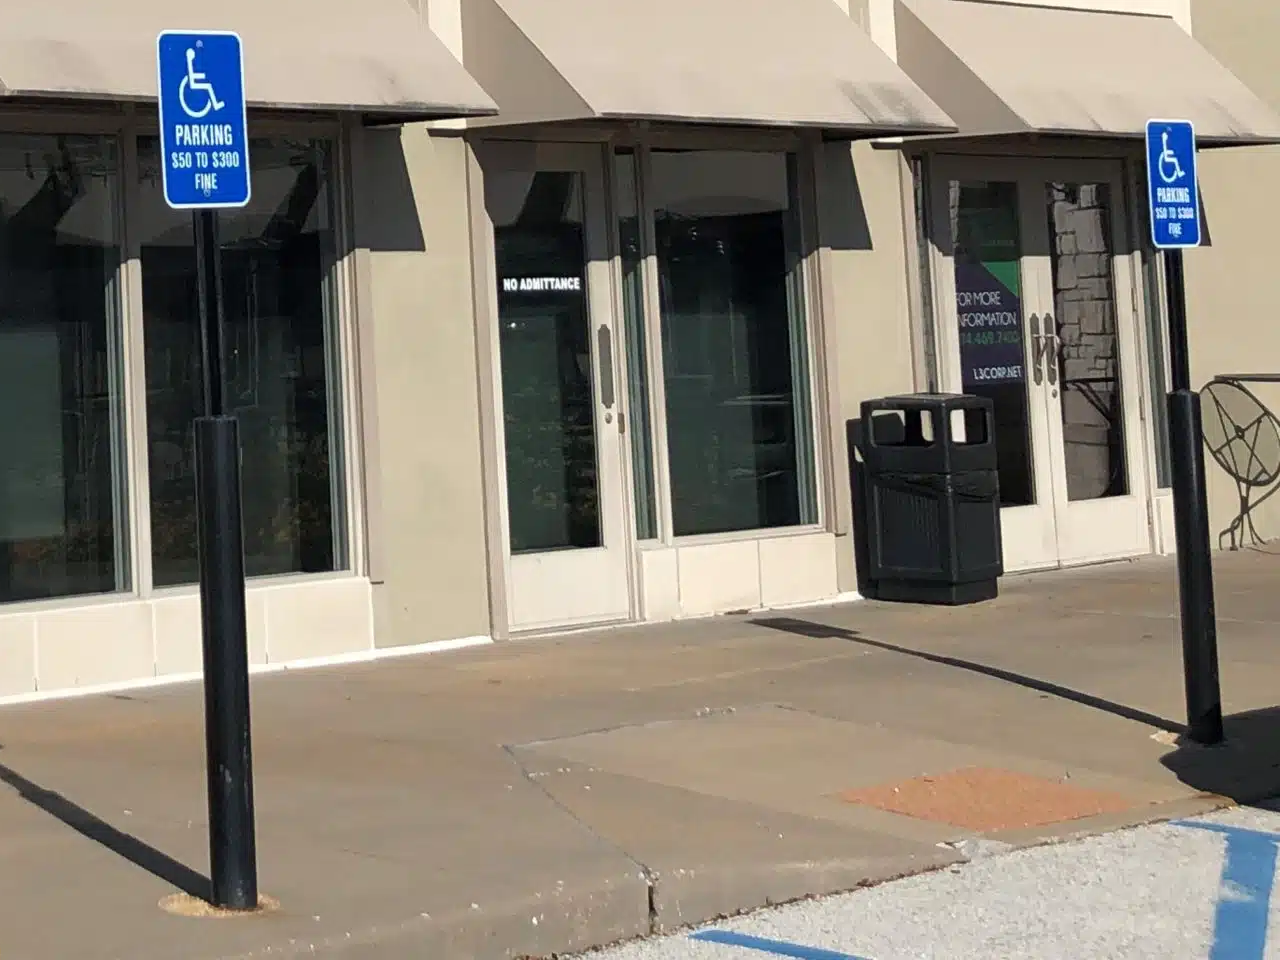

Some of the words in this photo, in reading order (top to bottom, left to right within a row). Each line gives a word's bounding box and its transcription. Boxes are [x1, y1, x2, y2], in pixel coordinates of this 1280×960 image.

[175, 123, 233, 146] PARKING
[171, 151, 192, 169] $50
[194, 151, 209, 168] TO
[211, 150, 240, 168] $300
[194, 172, 218, 190] FINE
[1156, 186, 1191, 203] PARKING
[503, 277, 519, 291] NO
[520, 276, 581, 291] ADMITTANCE
[973, 291, 1001, 306] MORE
